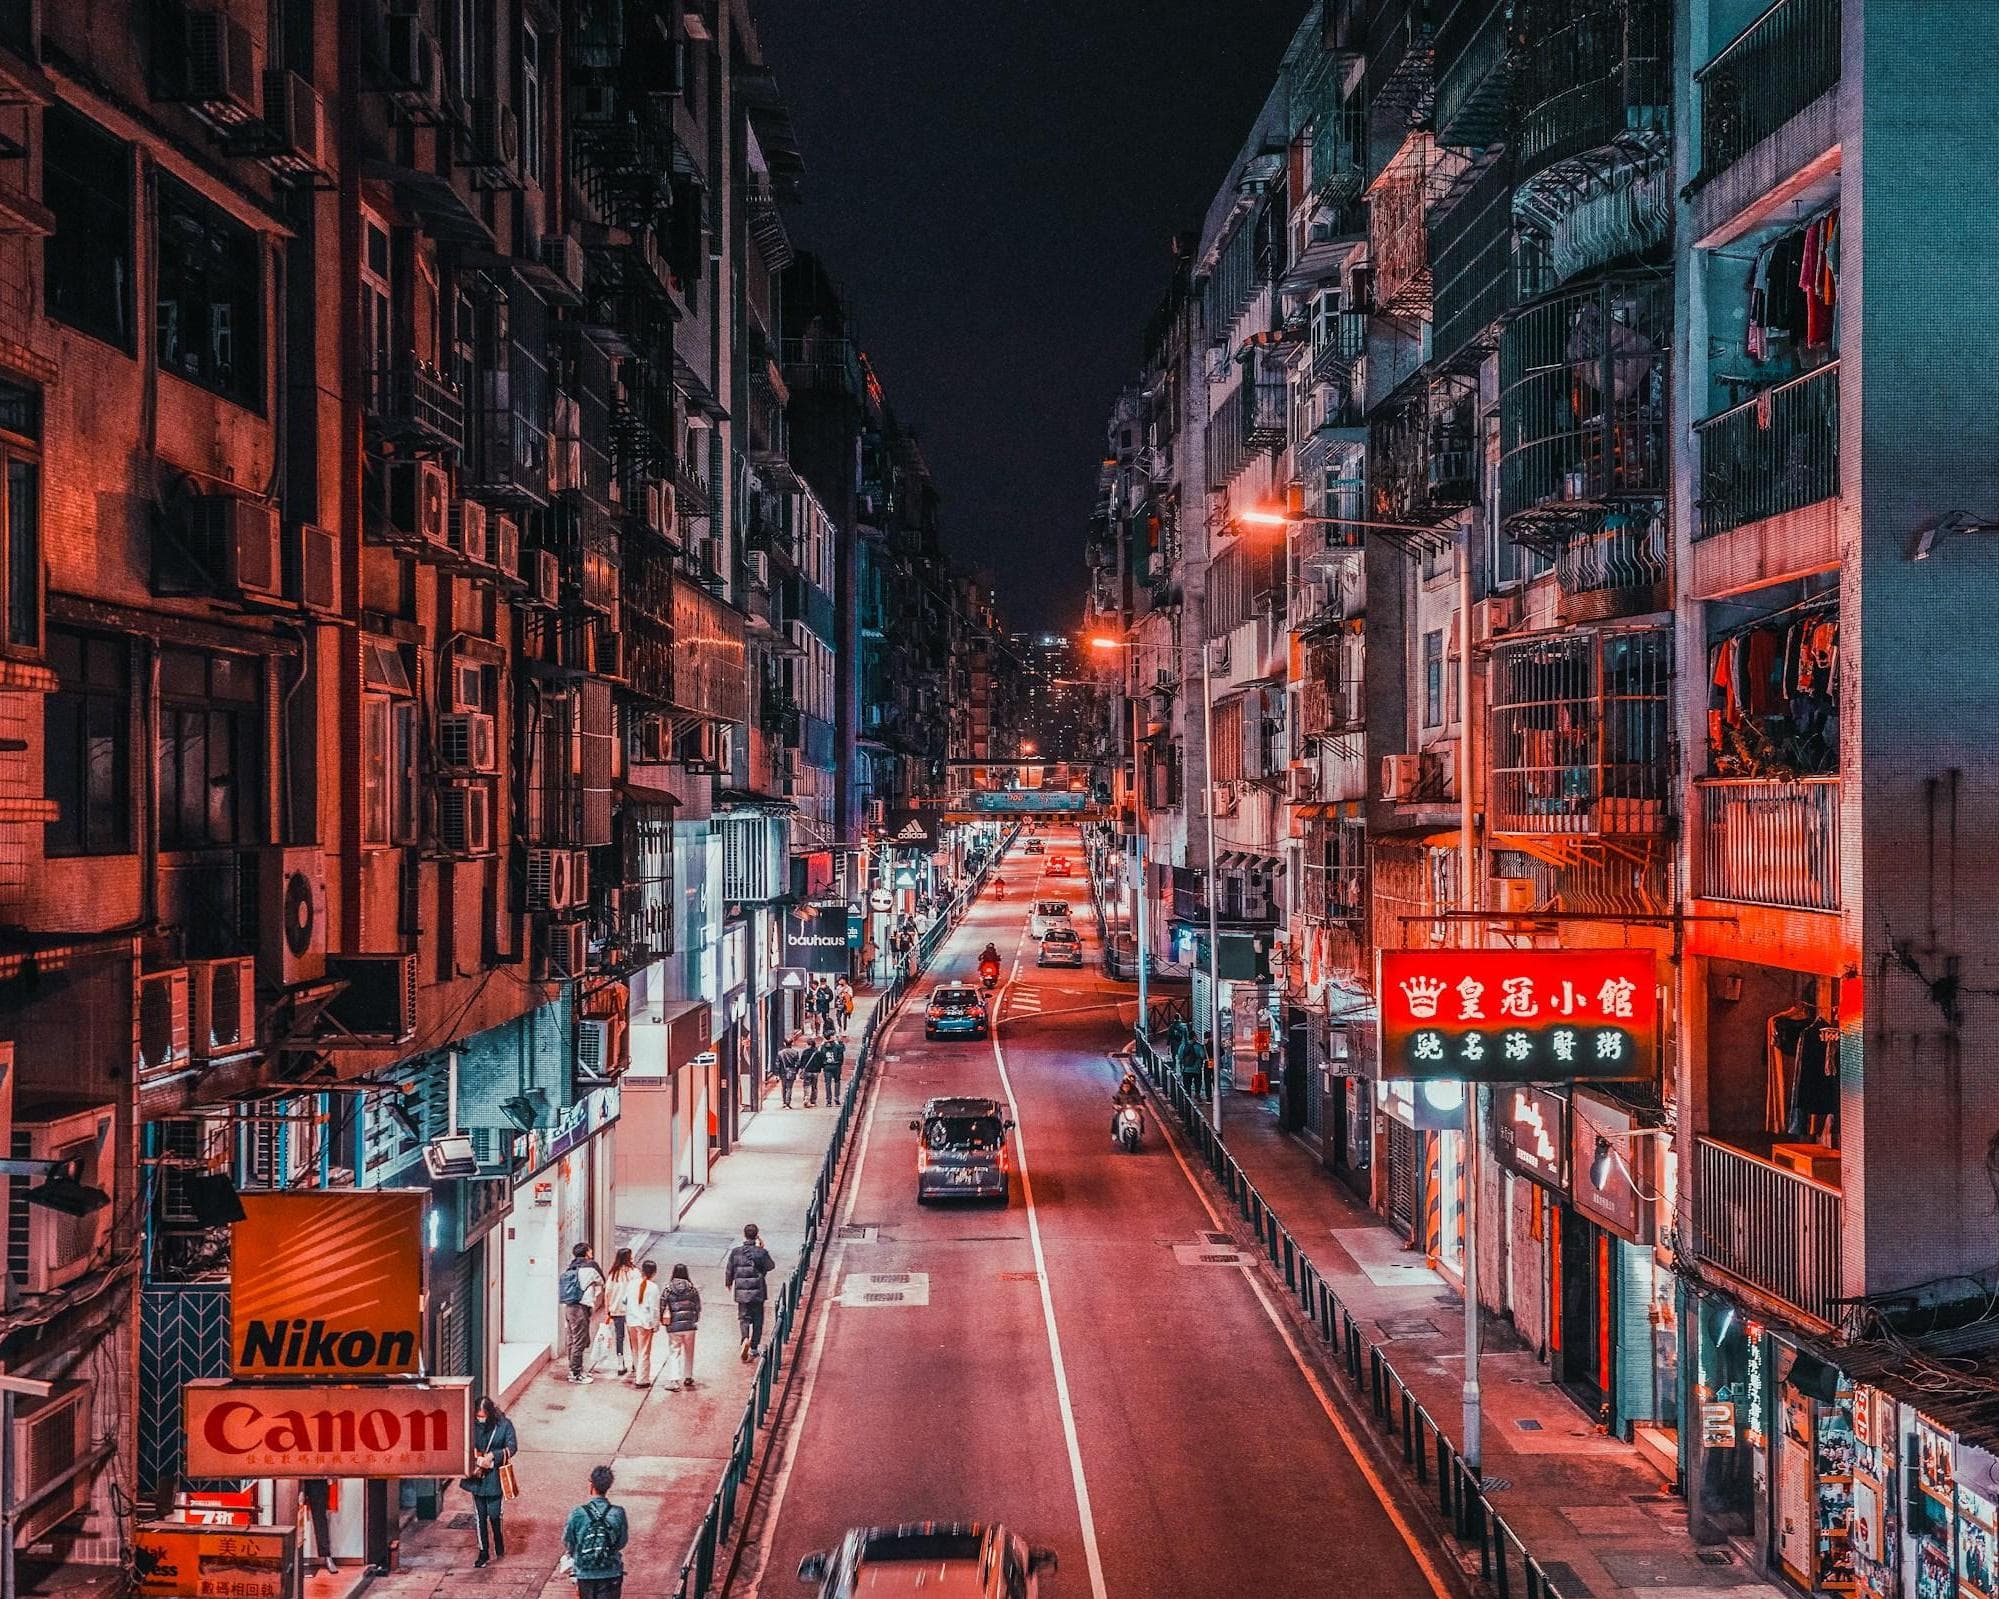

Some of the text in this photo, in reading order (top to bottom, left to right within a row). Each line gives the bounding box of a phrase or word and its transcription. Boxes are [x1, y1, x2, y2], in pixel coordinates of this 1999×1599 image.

[897, 831, 928, 839] adidas
[788, 934, 845, 947] bauhaus
[1456, 976, 1637, 1020] 皇冠小館
[1414, 1031, 1623, 1061] 馳名海蟹粥
[240, 1318, 415, 1368] Nikon
[204, 1401, 448, 1455] Canon
[218, 1537, 260, 1556] 美心
